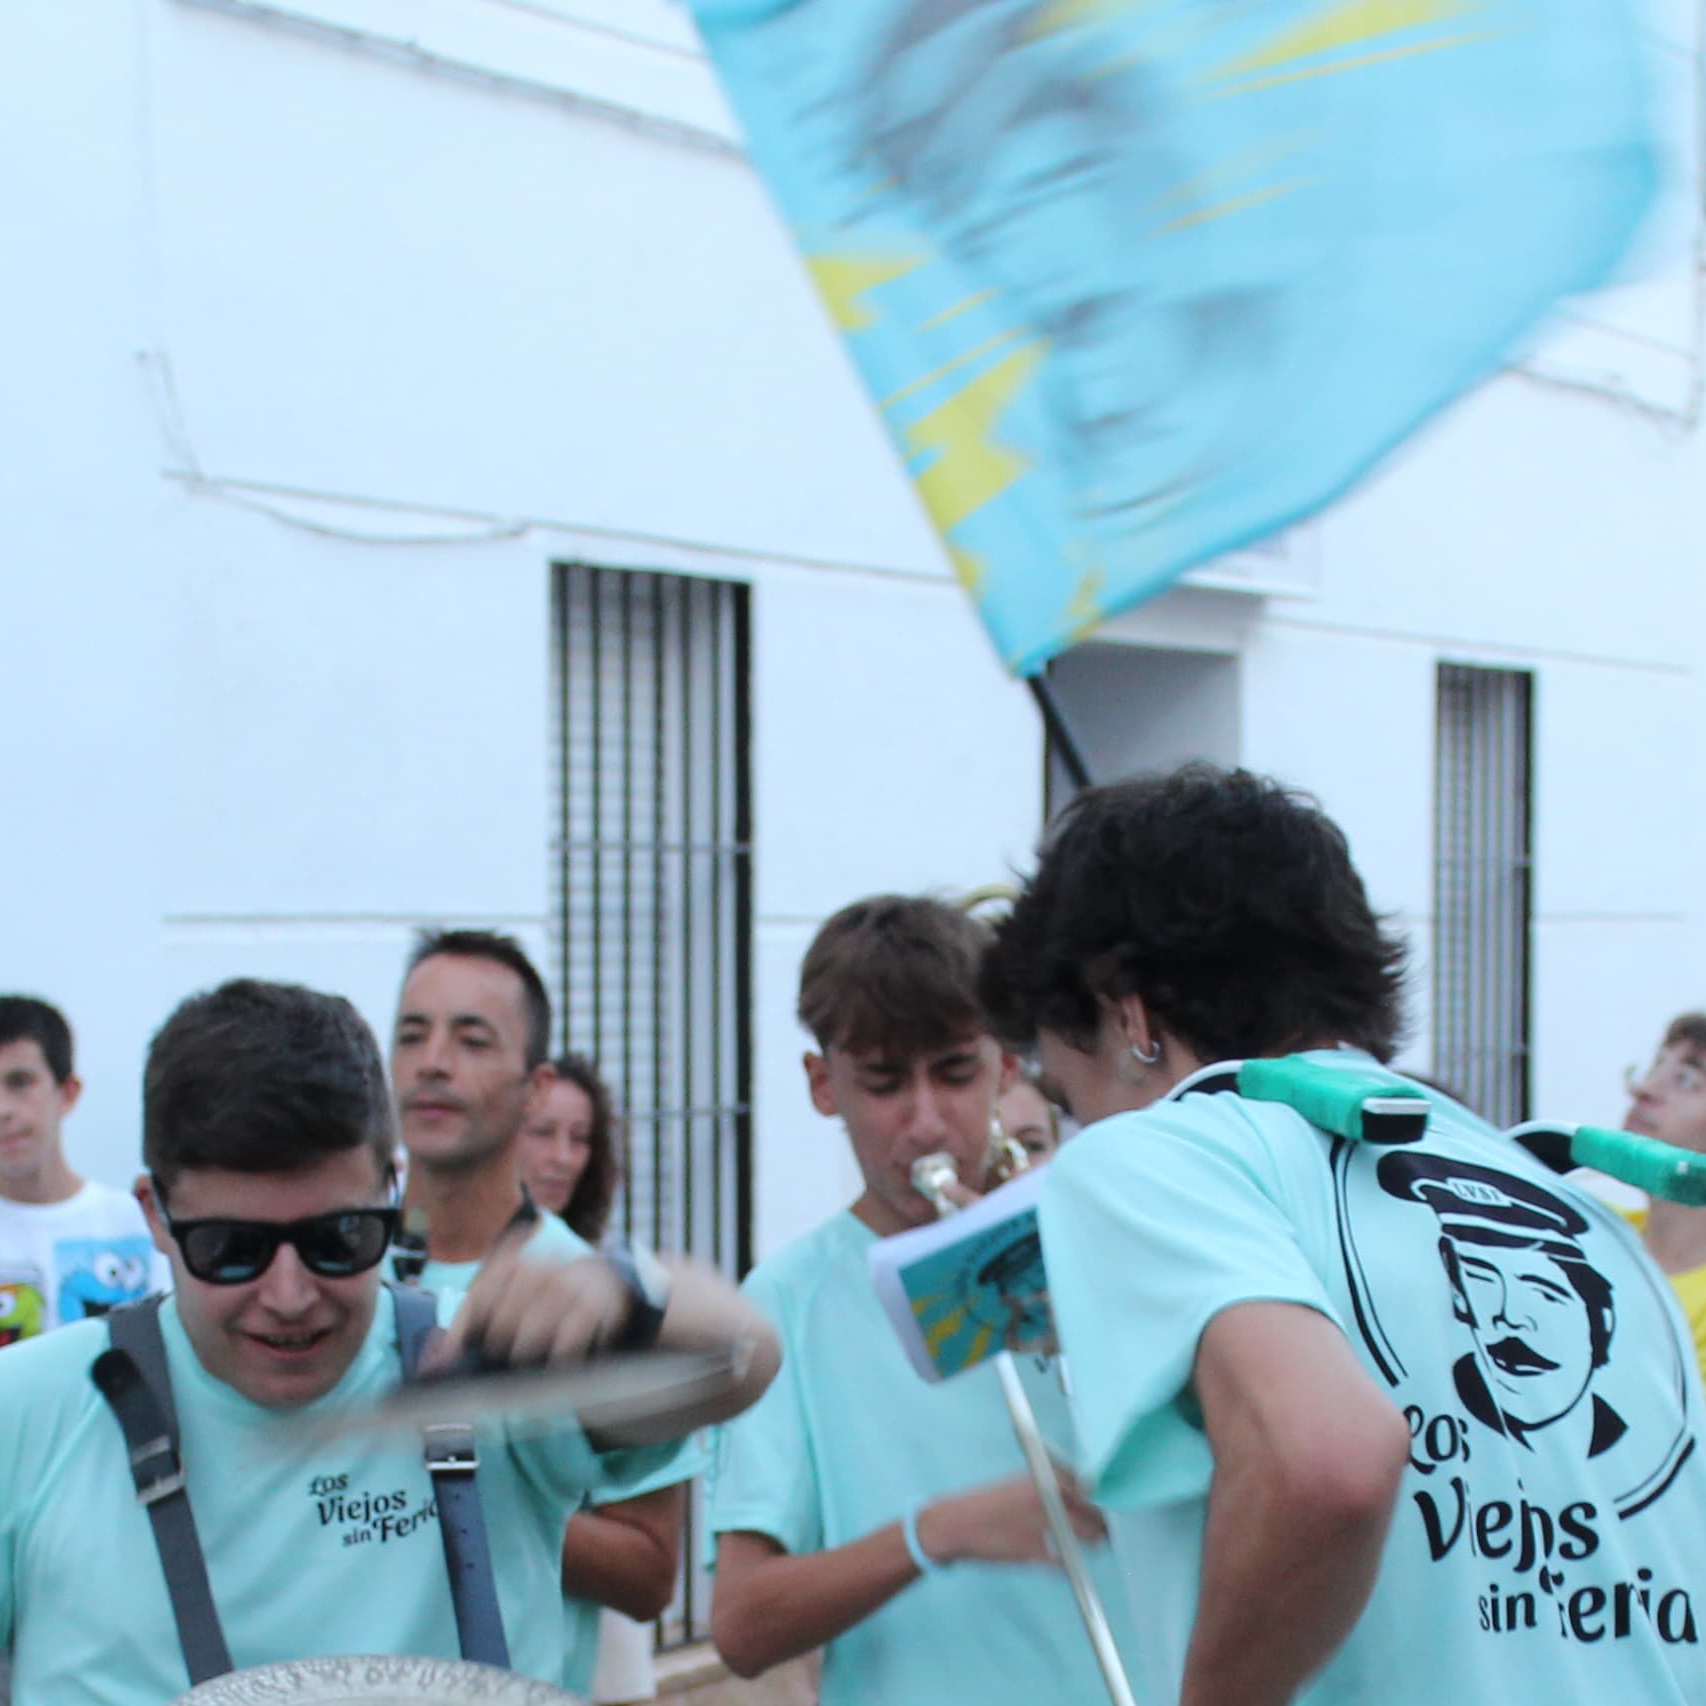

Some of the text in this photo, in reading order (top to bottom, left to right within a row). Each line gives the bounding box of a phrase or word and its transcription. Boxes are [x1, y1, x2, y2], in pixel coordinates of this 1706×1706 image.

[309, 1474, 349, 1496] Los
[317, 1490, 407, 1526] Viejos
[343, 1527, 372, 1547] sin
[1478, 1583, 1537, 1633] sin
